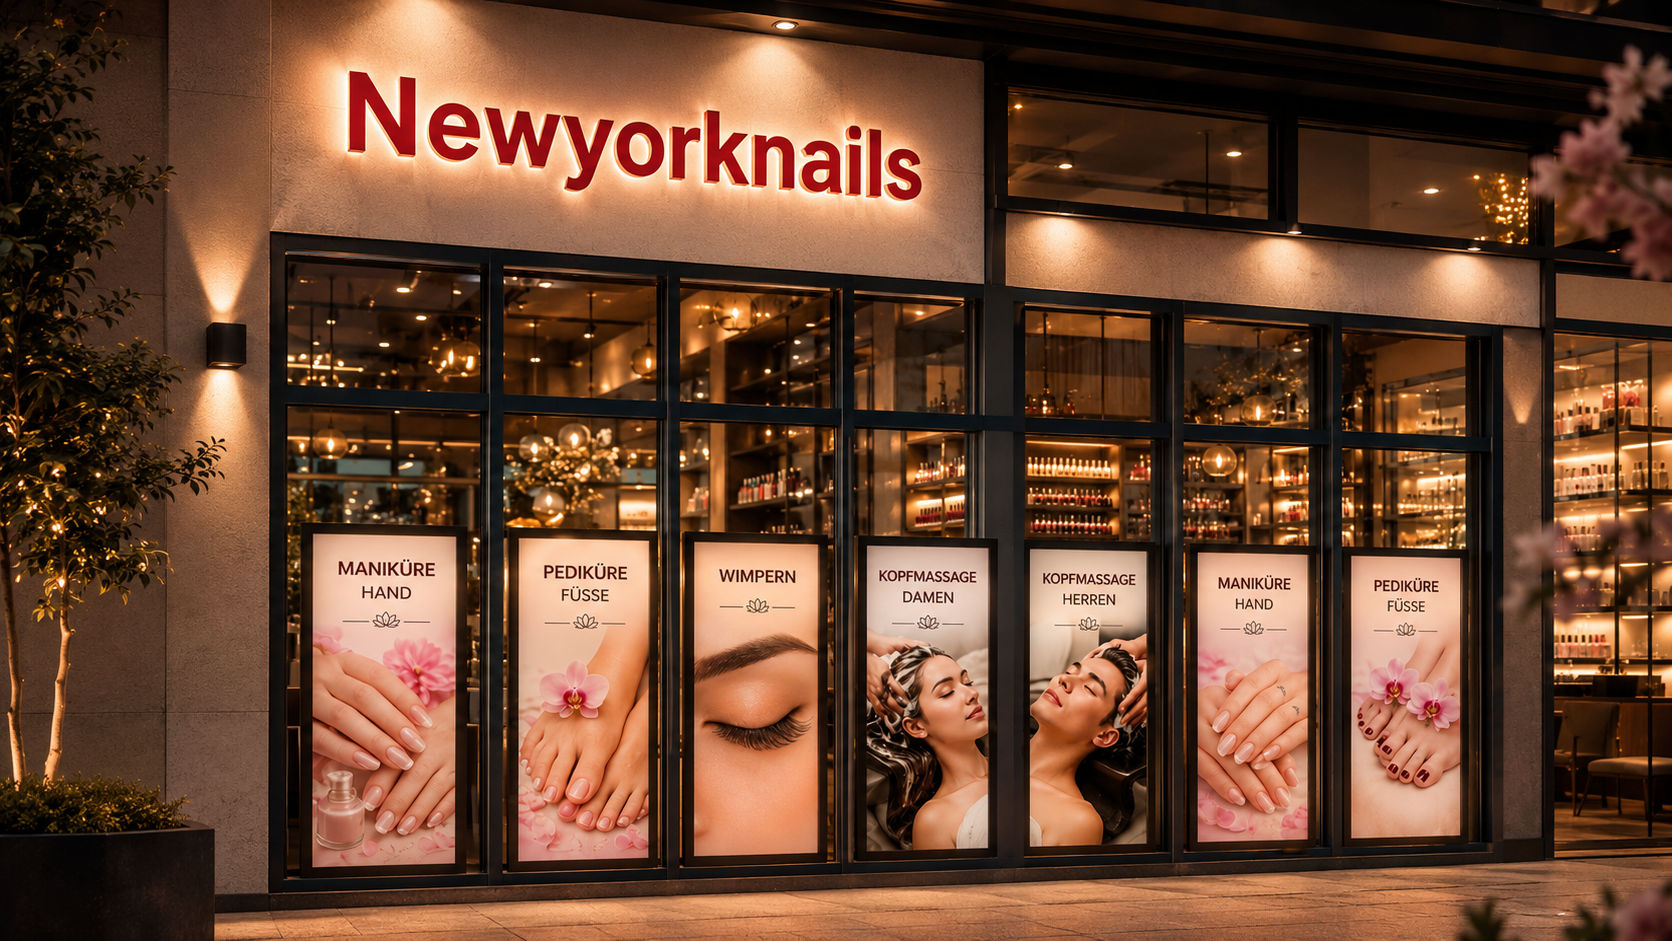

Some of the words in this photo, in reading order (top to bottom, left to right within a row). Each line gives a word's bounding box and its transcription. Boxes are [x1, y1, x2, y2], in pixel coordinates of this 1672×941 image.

[348, 70, 922, 201] Newyorknails
[338, 558, 436, 577] MANIKÜRE
[543, 562, 628, 581] PEDIKÜRE
[719, 568, 797, 584] WIMPERN
[878, 569, 977, 584] KOPFMASSAGE
[1042, 572, 1137, 586] KOPFMASSAGE
[1217, 574, 1292, 591] MANIKÜRE
[361, 585, 412, 600] HAND
[1373, 577, 1440, 593] PEDIKÜRE
[561, 585, 610, 603] FÜSSE
[902, 590, 954, 604] DAMEN
[1062, 593, 1116, 606] HERREN
[1235, 597, 1274, 611] HAND
[1387, 597, 1426, 613] FÜSSE
